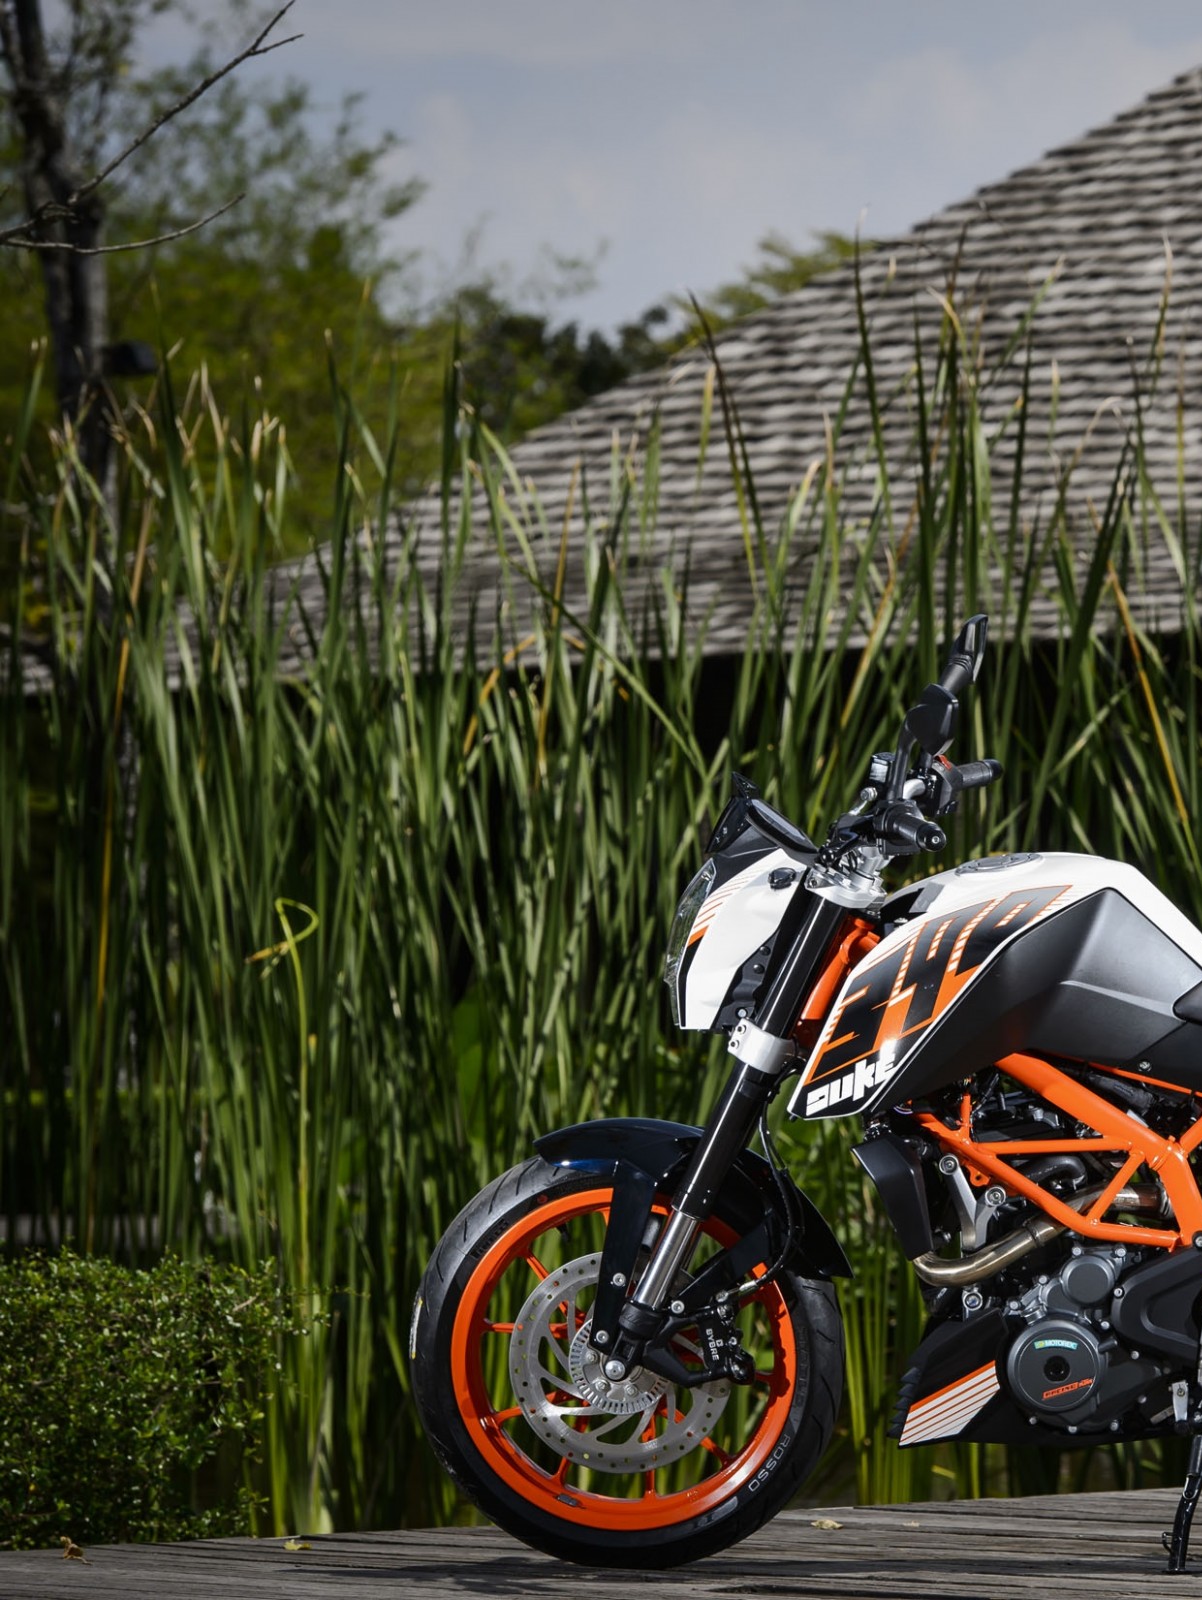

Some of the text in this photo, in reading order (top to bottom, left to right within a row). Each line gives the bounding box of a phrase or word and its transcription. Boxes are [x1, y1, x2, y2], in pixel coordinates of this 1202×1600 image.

[806, 1053, 898, 1116] DUKE
[705, 1328, 720, 1361] BYBRE
[748, 1434, 791, 1492] ROSSO
